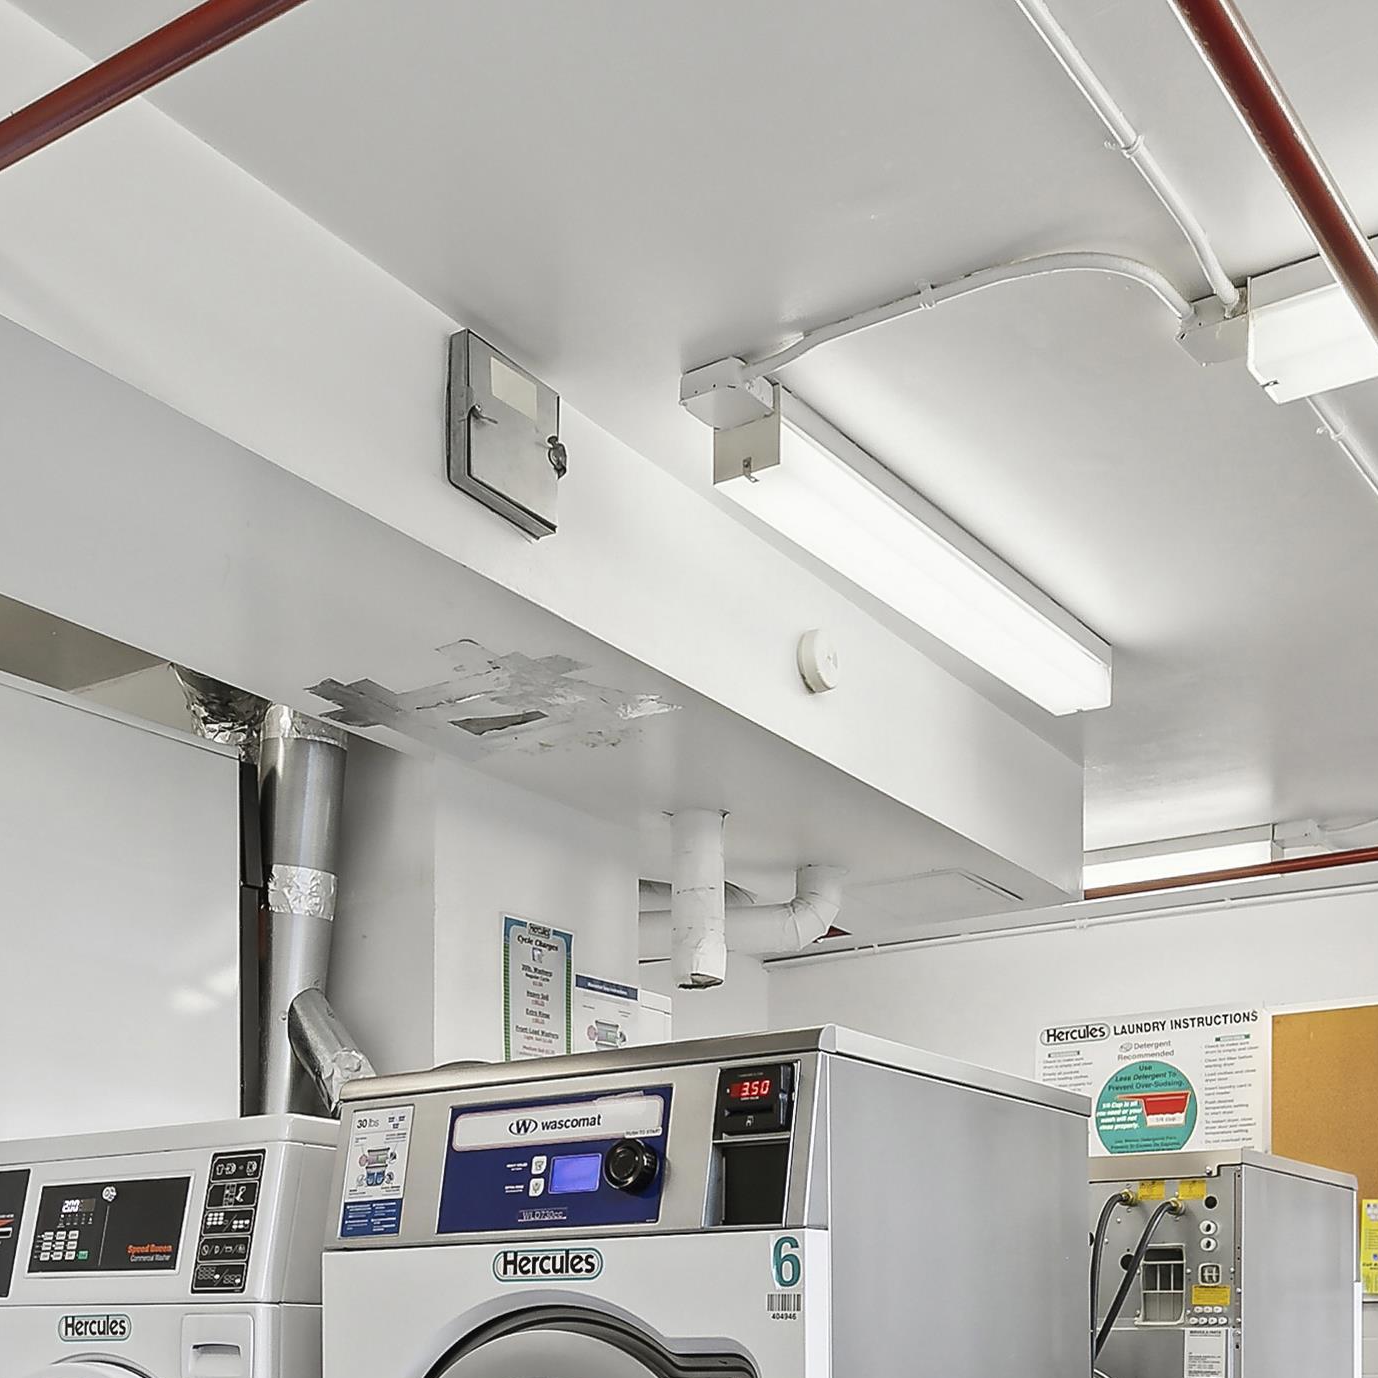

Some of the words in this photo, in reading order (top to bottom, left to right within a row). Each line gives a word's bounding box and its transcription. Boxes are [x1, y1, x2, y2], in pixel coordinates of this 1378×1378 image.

[517, 935, 533, 945] Cycle
[535, 939, 558, 951] Charges
[1047, 1025, 1106, 1043] Hercules
[1114, 1020, 1167, 1035] LAUNDRY
[1171, 1011, 1259, 1030] INSTRUCTIONS
[1134, 1040, 1171, 1050] Detergent
[1117, 1050, 1174, 1061] Recommended
[1133, 1072, 1167, 1080] Detergent
[357, 1119, 367, 1129] 30
[369, 1119, 379, 1127] lbs
[541, 1114, 602, 1132] wascomat
[127, 1244, 150, 1254] Speed
[501, 1248, 597, 1276] Hercules
[772, 1236, 801, 1287] 6
[64, 1316, 127, 1338] Hercules
